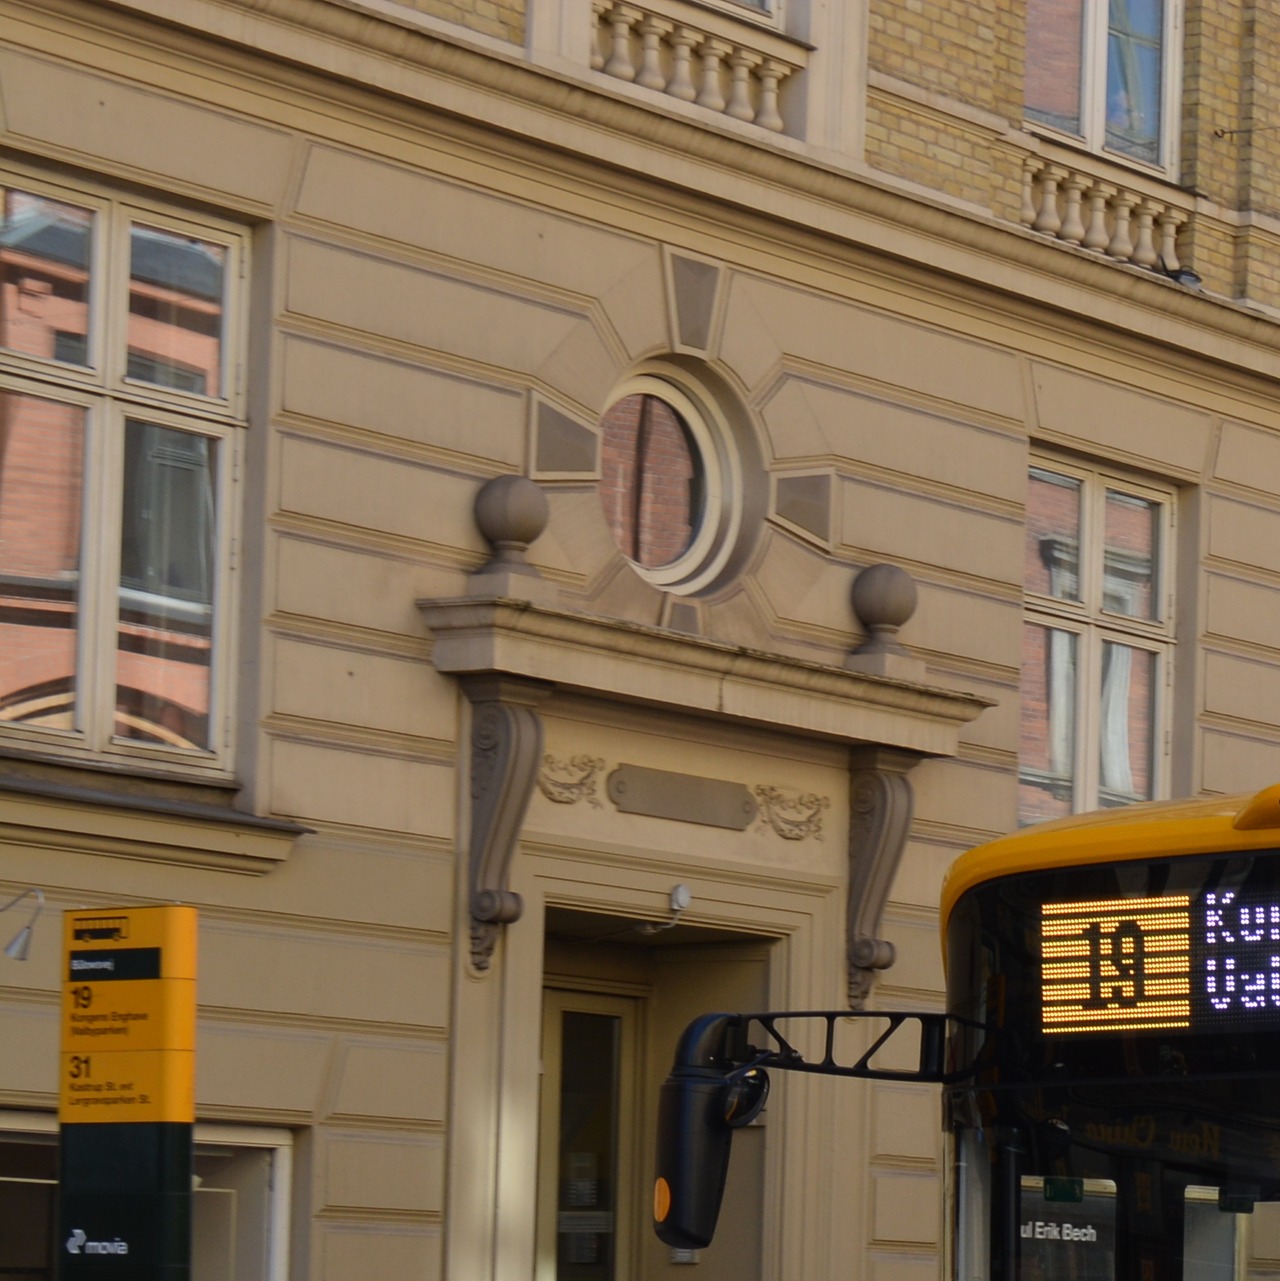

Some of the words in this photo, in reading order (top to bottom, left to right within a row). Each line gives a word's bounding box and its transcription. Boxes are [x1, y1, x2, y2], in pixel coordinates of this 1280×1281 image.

[1079, 918, 1145, 1010] 19
[71, 986, 92, 1008] 19
[69, 1056, 91, 1078] 31
[1035, 1221, 1060, 1239] Erik
[1062, 1223, 1096, 1241] Bech
[85, 1237, 128, 1254] movia
